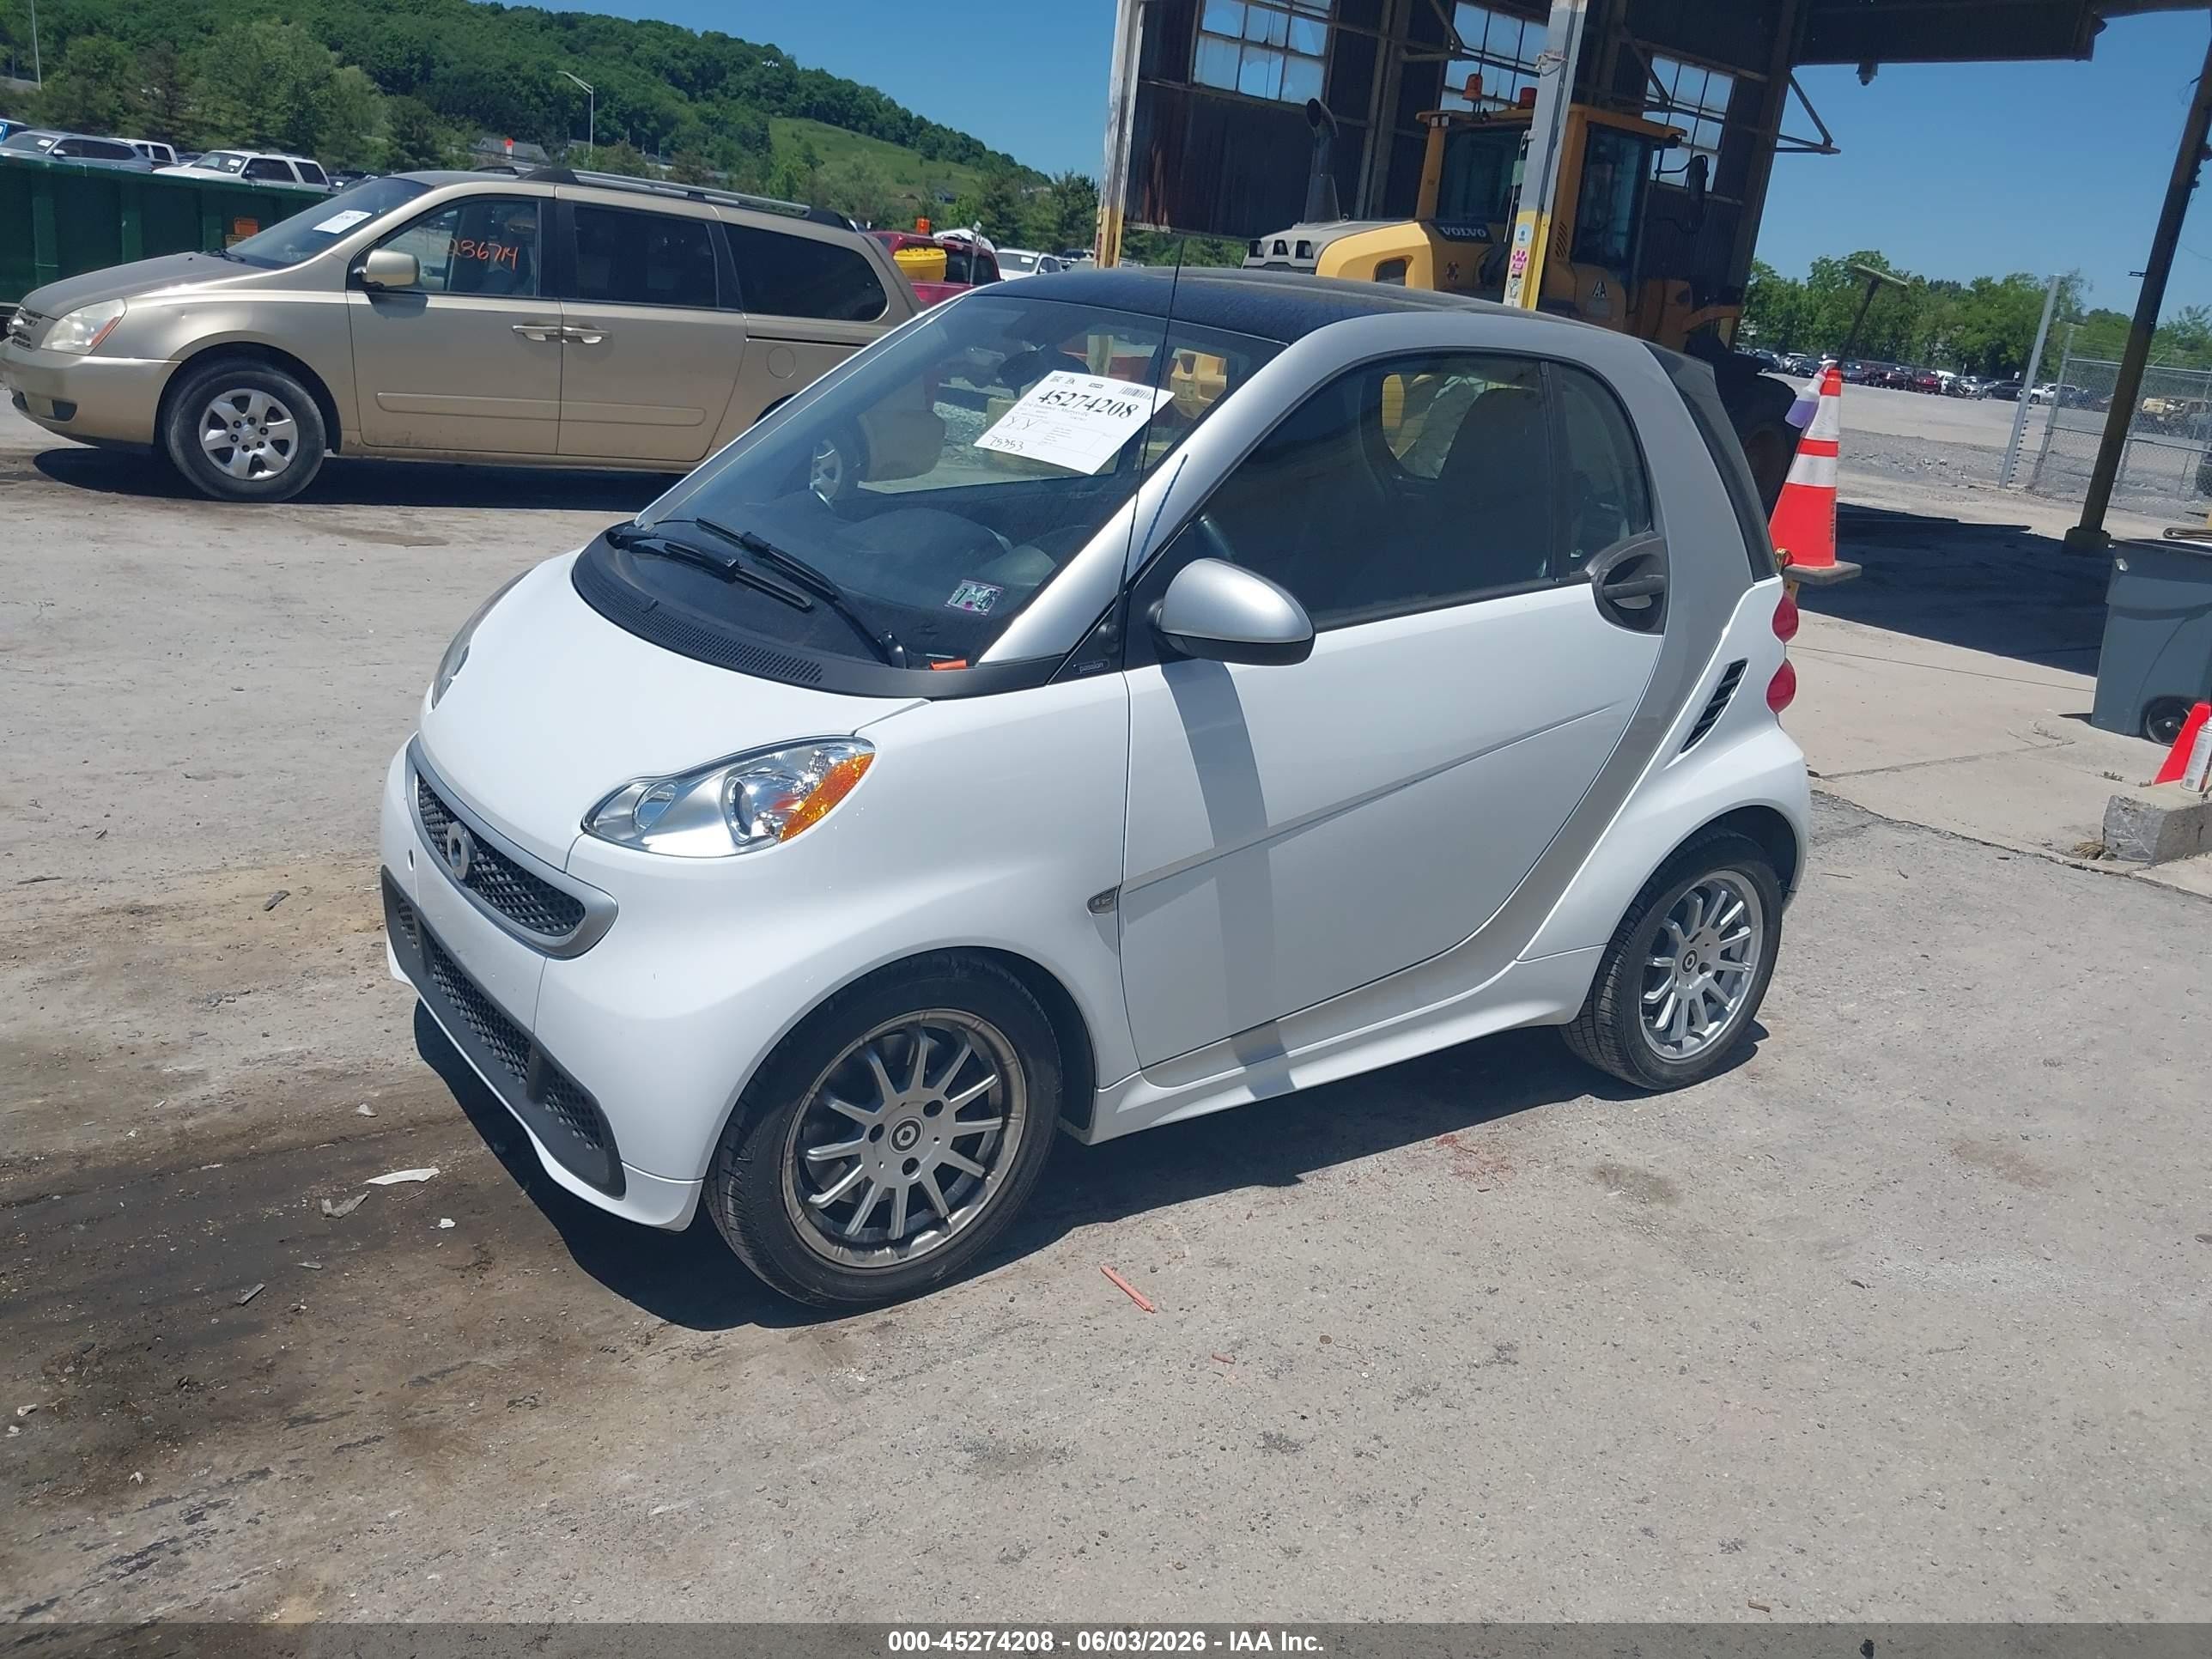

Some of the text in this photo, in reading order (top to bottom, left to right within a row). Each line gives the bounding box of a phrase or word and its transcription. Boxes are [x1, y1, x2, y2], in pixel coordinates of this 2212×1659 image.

[1440, 227, 1486, 237] VOLVO
[1038, 390, 1139, 419] 45274208
[1079, 661, 1103, 674] passion
